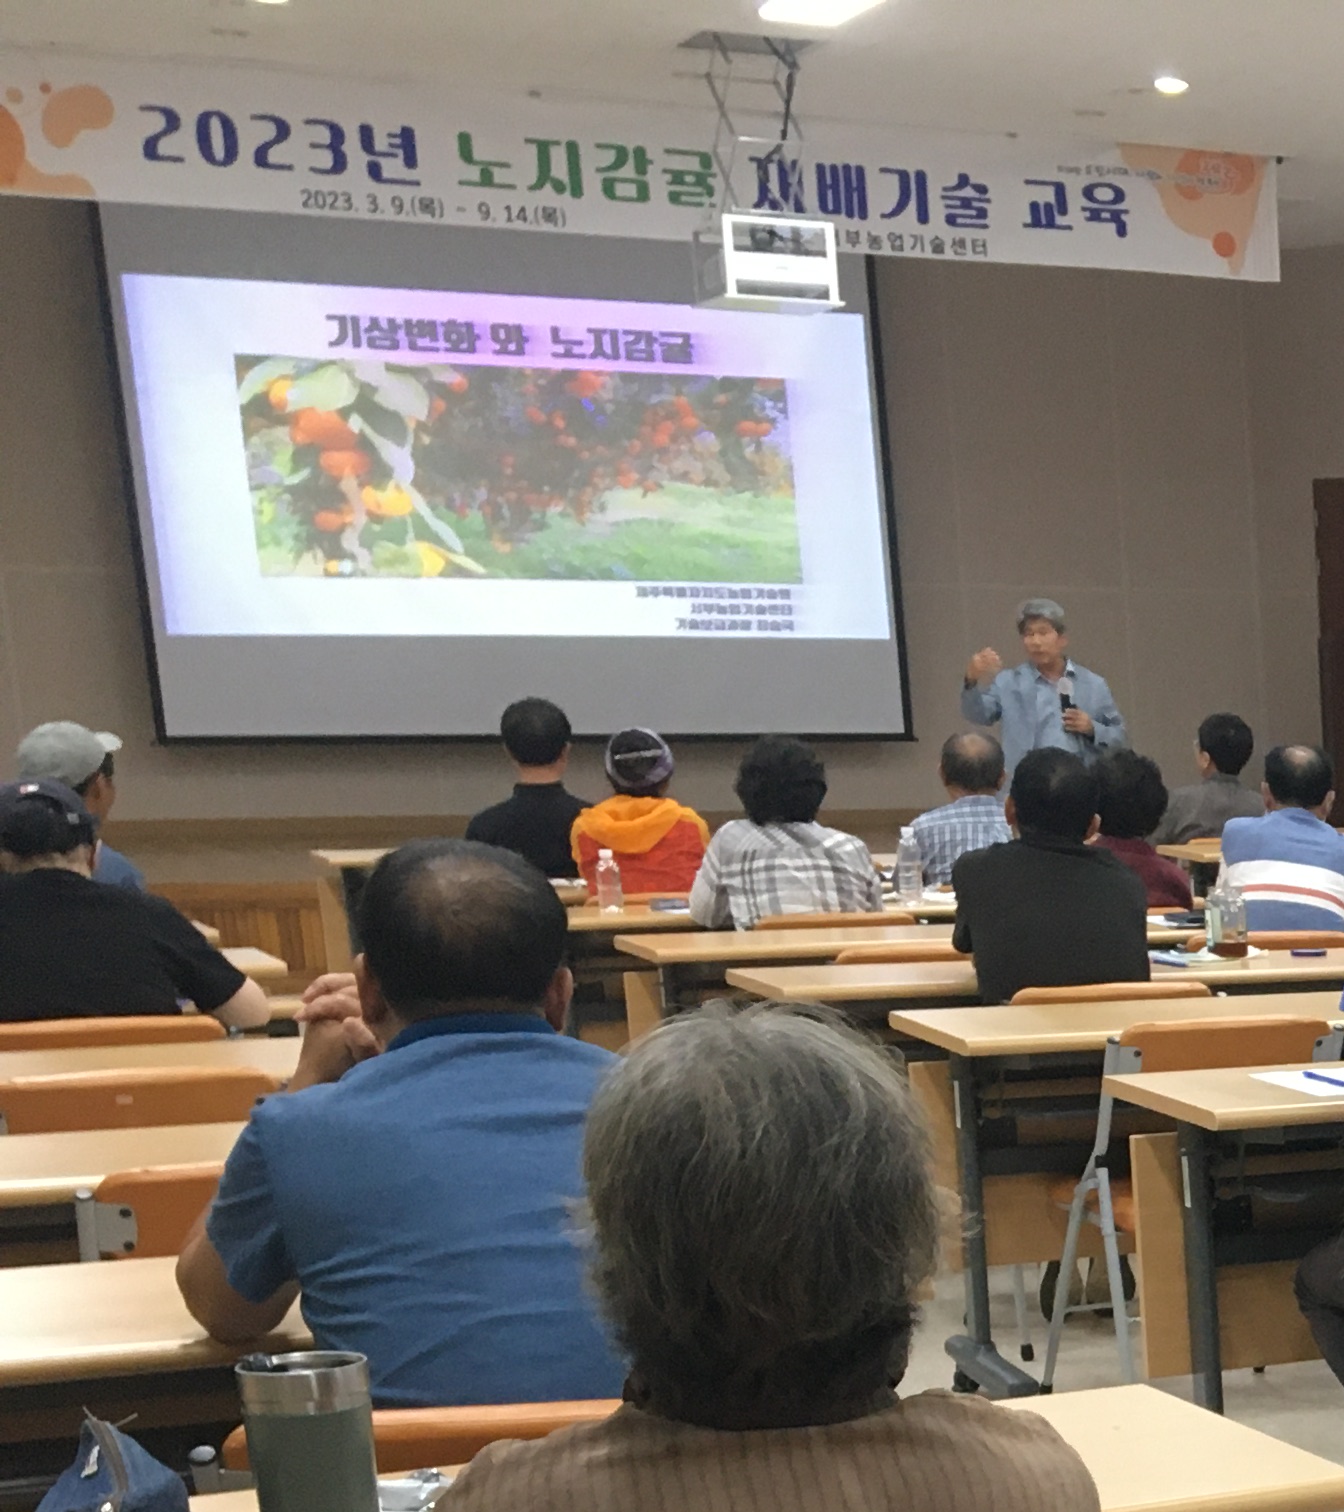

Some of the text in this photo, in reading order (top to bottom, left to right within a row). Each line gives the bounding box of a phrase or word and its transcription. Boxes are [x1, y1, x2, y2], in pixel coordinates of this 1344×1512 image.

[138, 102, 422, 188] 2023년
[457, 130, 718, 207] 노지감귤
[748, 155, 993, 230] 재배기술
[1022, 177, 1131, 238] 교육
[300, 188, 359, 213] 2023.
[366, 193, 385, 214] 3.
[477, 201, 496, 222] 9.
[325, 314, 694, 365] 기상변화 와 노지감귤
